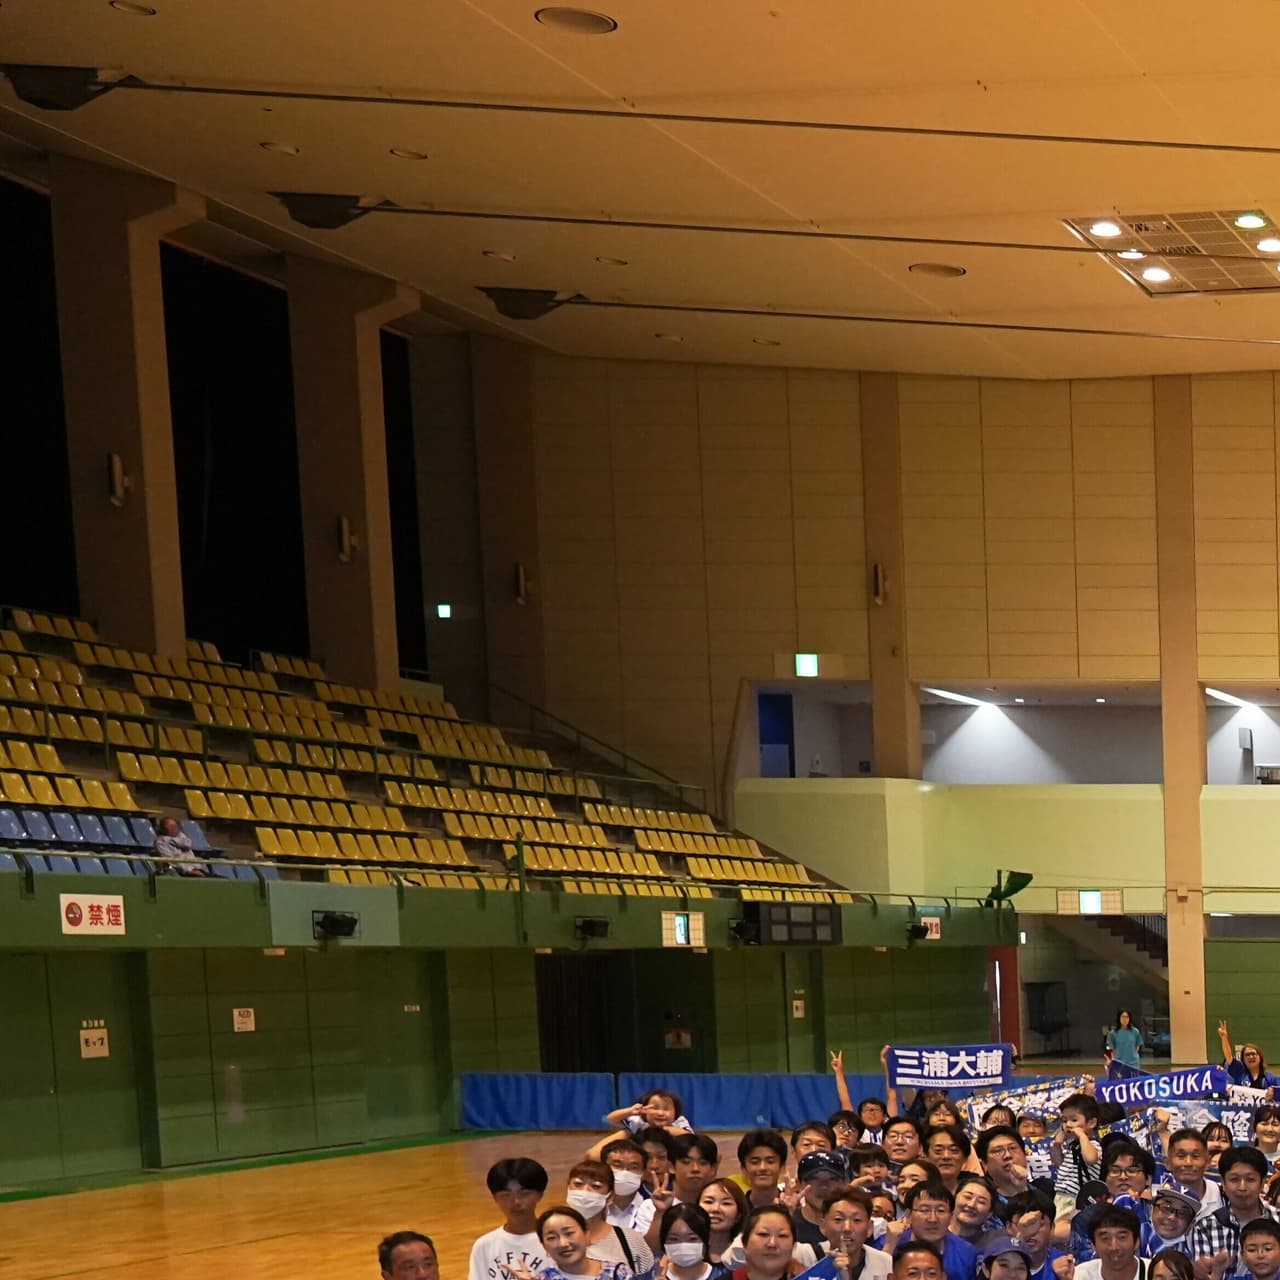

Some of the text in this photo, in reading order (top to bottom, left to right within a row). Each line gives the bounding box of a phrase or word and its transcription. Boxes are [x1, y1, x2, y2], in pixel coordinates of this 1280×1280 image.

[88, 904, 122, 926] 禁煙
[895, 1049, 1004, 1078] 三浦大輔
[1102, 1070, 1213, 1103] YOKOSUKA
